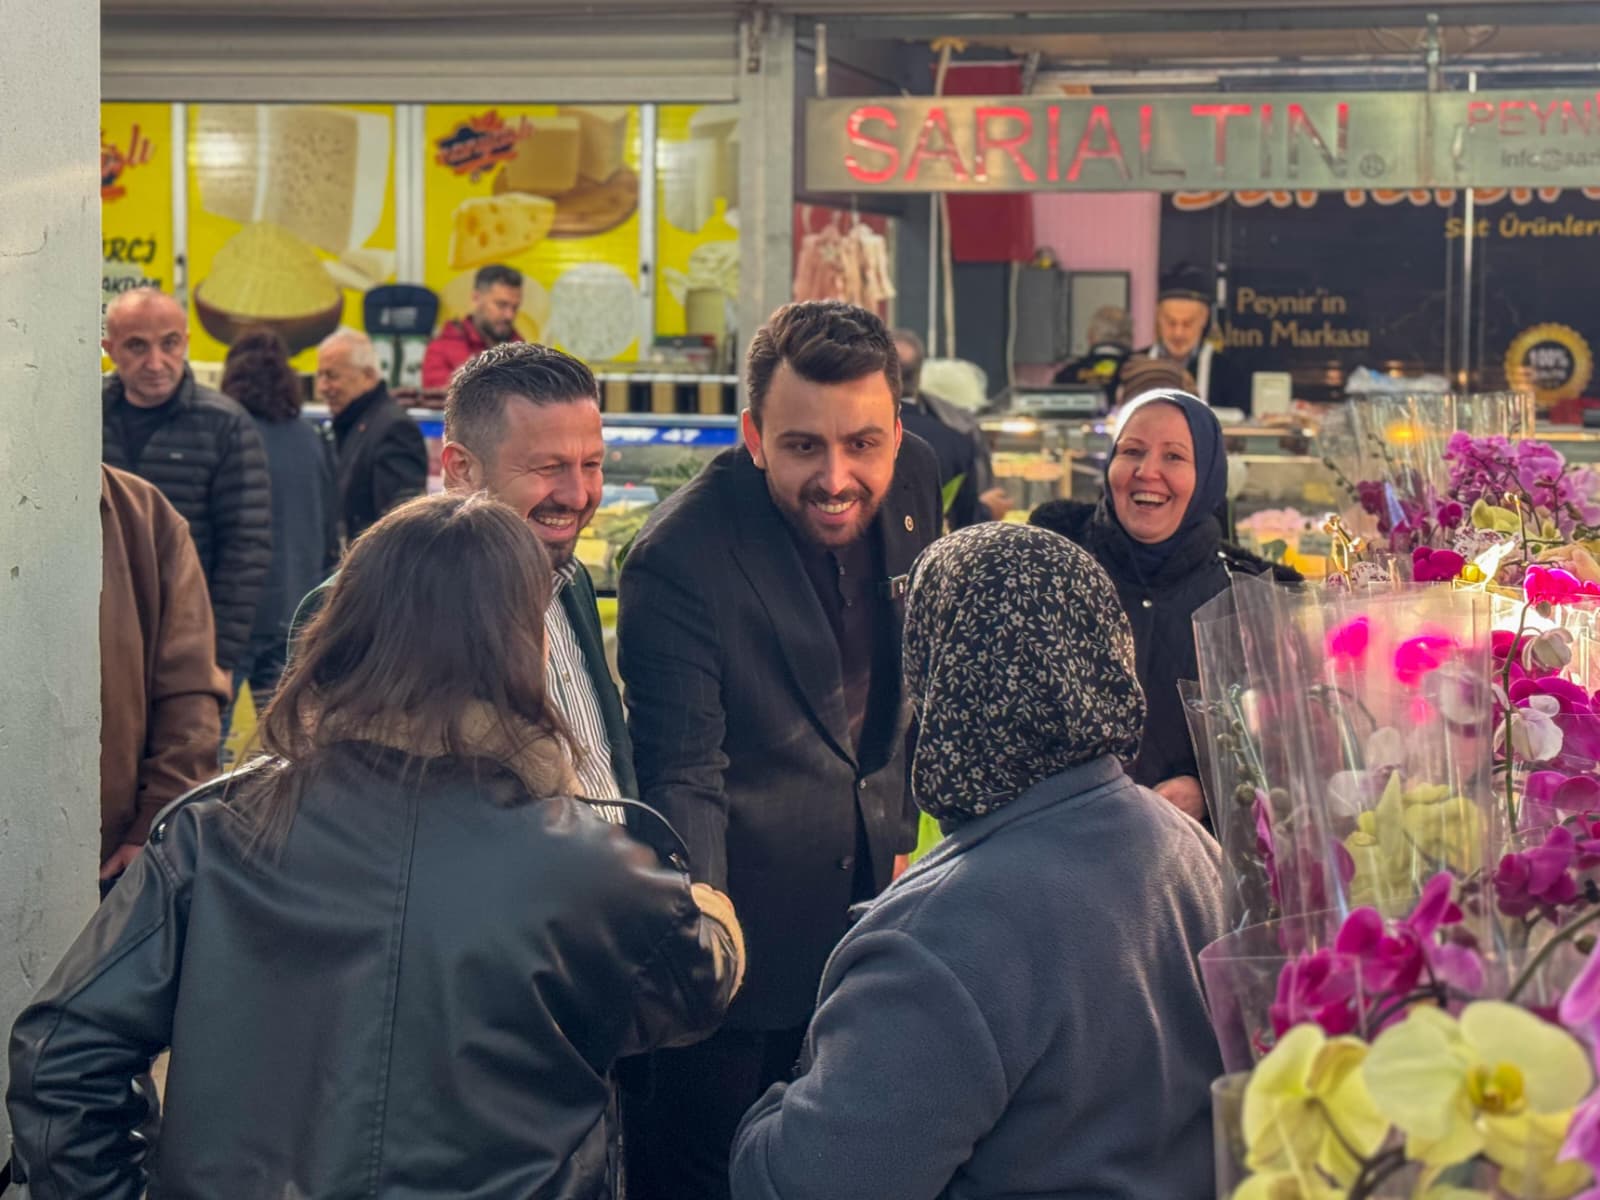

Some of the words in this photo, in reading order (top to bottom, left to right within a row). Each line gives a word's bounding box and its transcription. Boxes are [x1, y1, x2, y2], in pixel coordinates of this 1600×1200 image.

[844, 103, 1349, 184] SARIALTIN
[1445, 217, 1490, 238] St
[1236, 286, 1346, 318] Peynir'in
[1270, 319, 1370, 347] Markası
